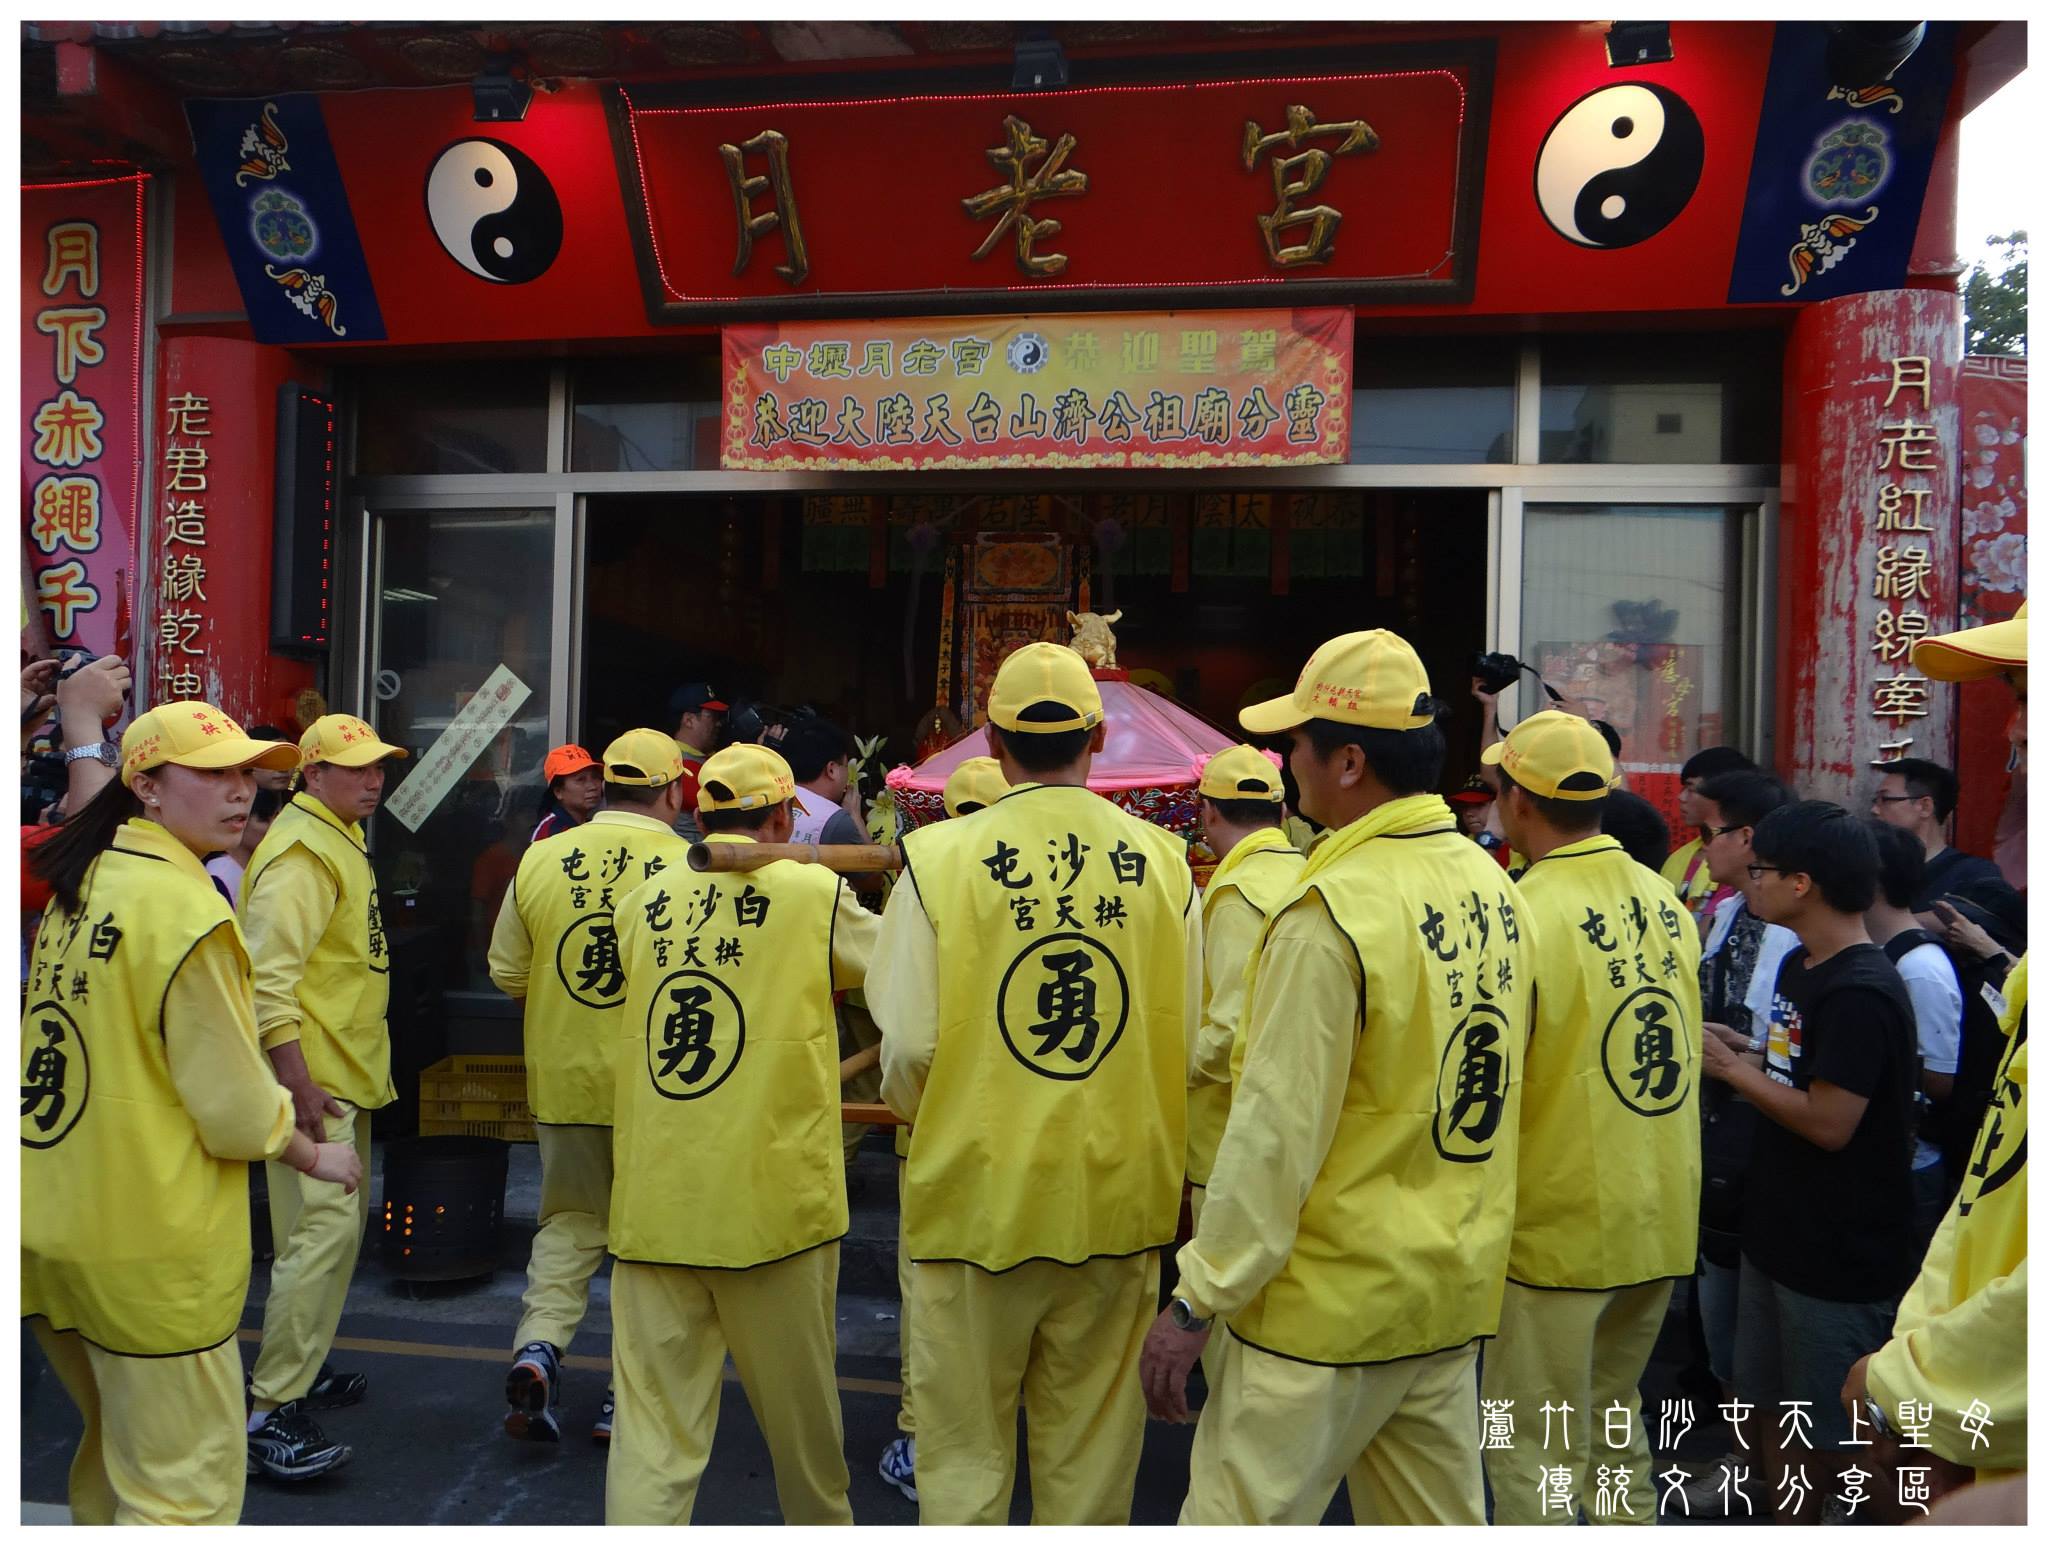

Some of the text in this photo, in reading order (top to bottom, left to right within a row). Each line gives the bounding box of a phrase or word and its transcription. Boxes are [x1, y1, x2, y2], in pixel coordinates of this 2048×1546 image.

[717, 104, 1380, 286] 月老宮
[762, 335, 993, 383] 中壢月老宮
[1063, 328, 1278, 375] 恭迎聖駕
[29, 221, 106, 641] 月下赤繩千
[749, 383, 1325, 449] 恭迎大陸天台山濟公祖廟分靈
[159, 392, 212, 701] 老君造緣乾坤
[982, 834, 1146, 890] 白沙屯
[570, 885, 618, 911] 天宮
[644, 883, 771, 932] 白沙屯
[1010, 895, 1128, 931] 拱天宮
[1419, 891, 1520, 961] 白沙屯
[1580, 896, 1682, 952] 白沙屯
[652, 937, 743, 968] 拱天宮
[1607, 951, 1679, 989] 拱天宮
[1028, 950, 1101, 1064] 勇
[1447, 957, 1513, 1008] 拱天宮
[657, 985, 716, 1084] 勇
[1630, 1000, 1682, 1100] 勇
[1445, 1021, 1504, 1144] 勇
